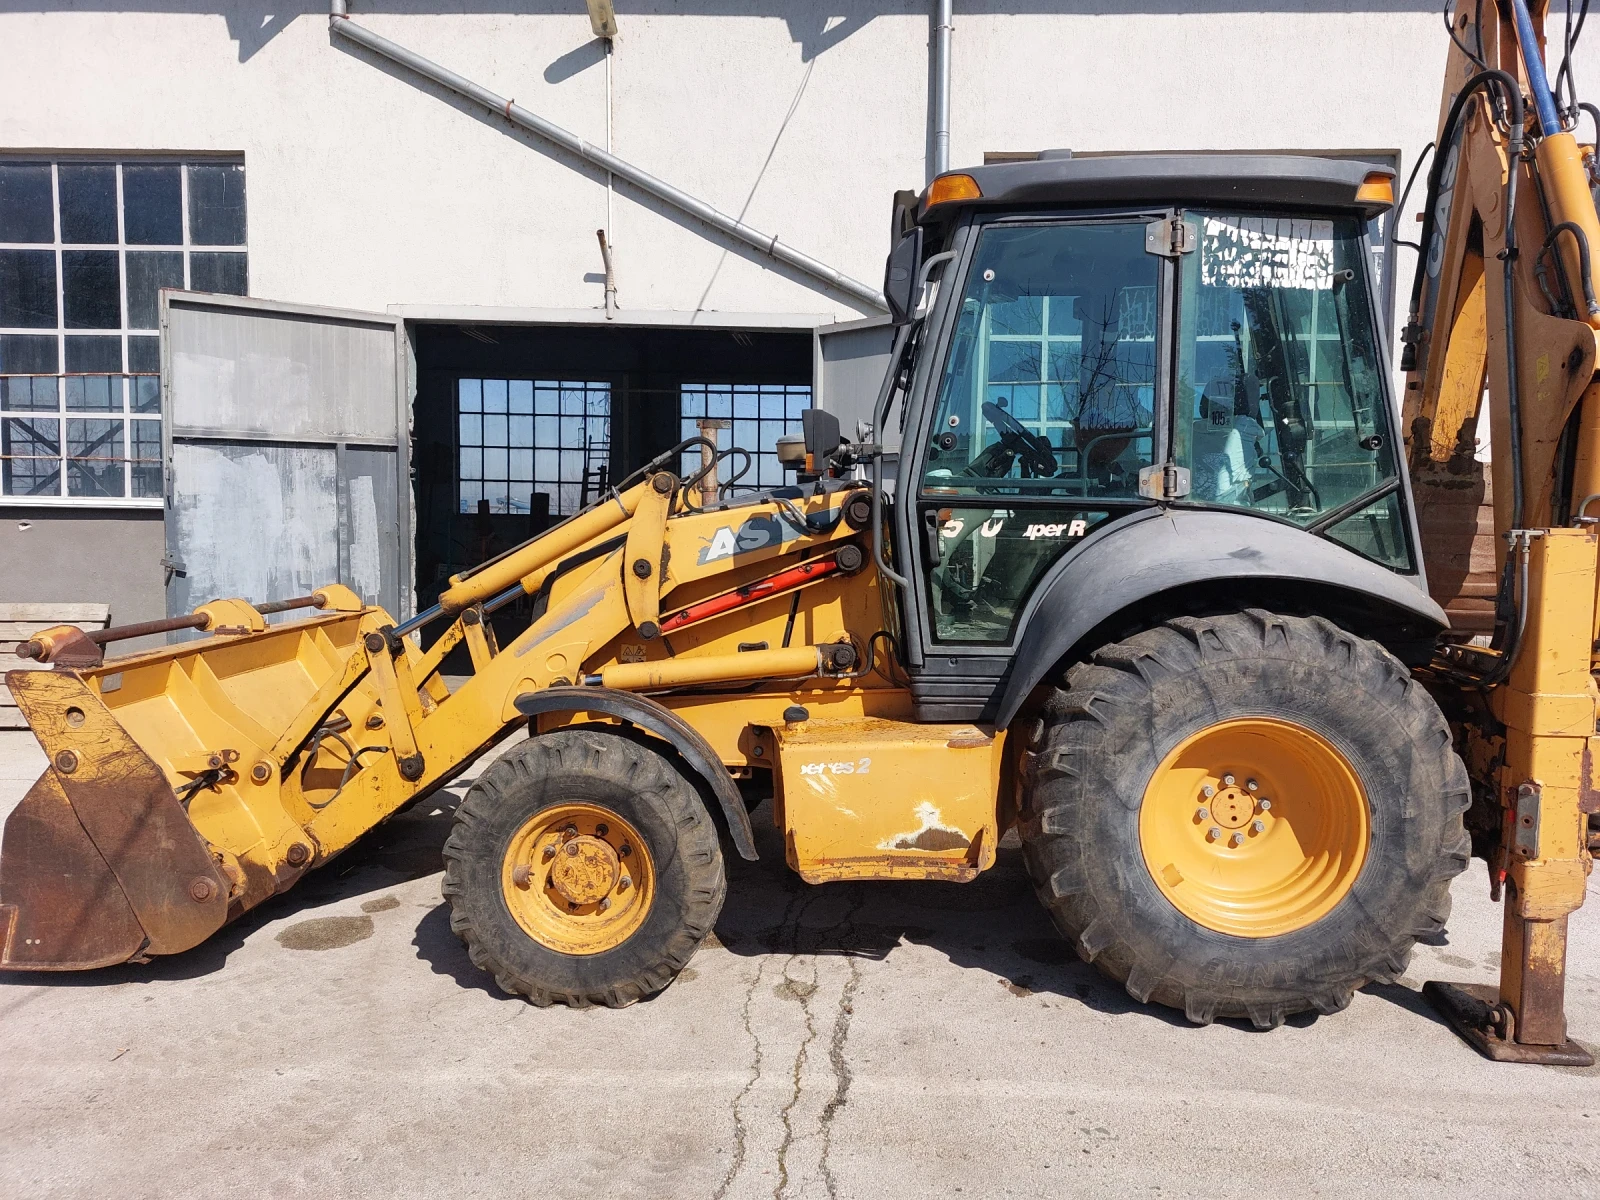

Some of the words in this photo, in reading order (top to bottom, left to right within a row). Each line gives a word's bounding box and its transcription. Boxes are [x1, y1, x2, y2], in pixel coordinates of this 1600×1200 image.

[1212, 411, 1226, 426] 105
[1067, 520, 1086, 537] R
[856, 757, 872, 774] 2
